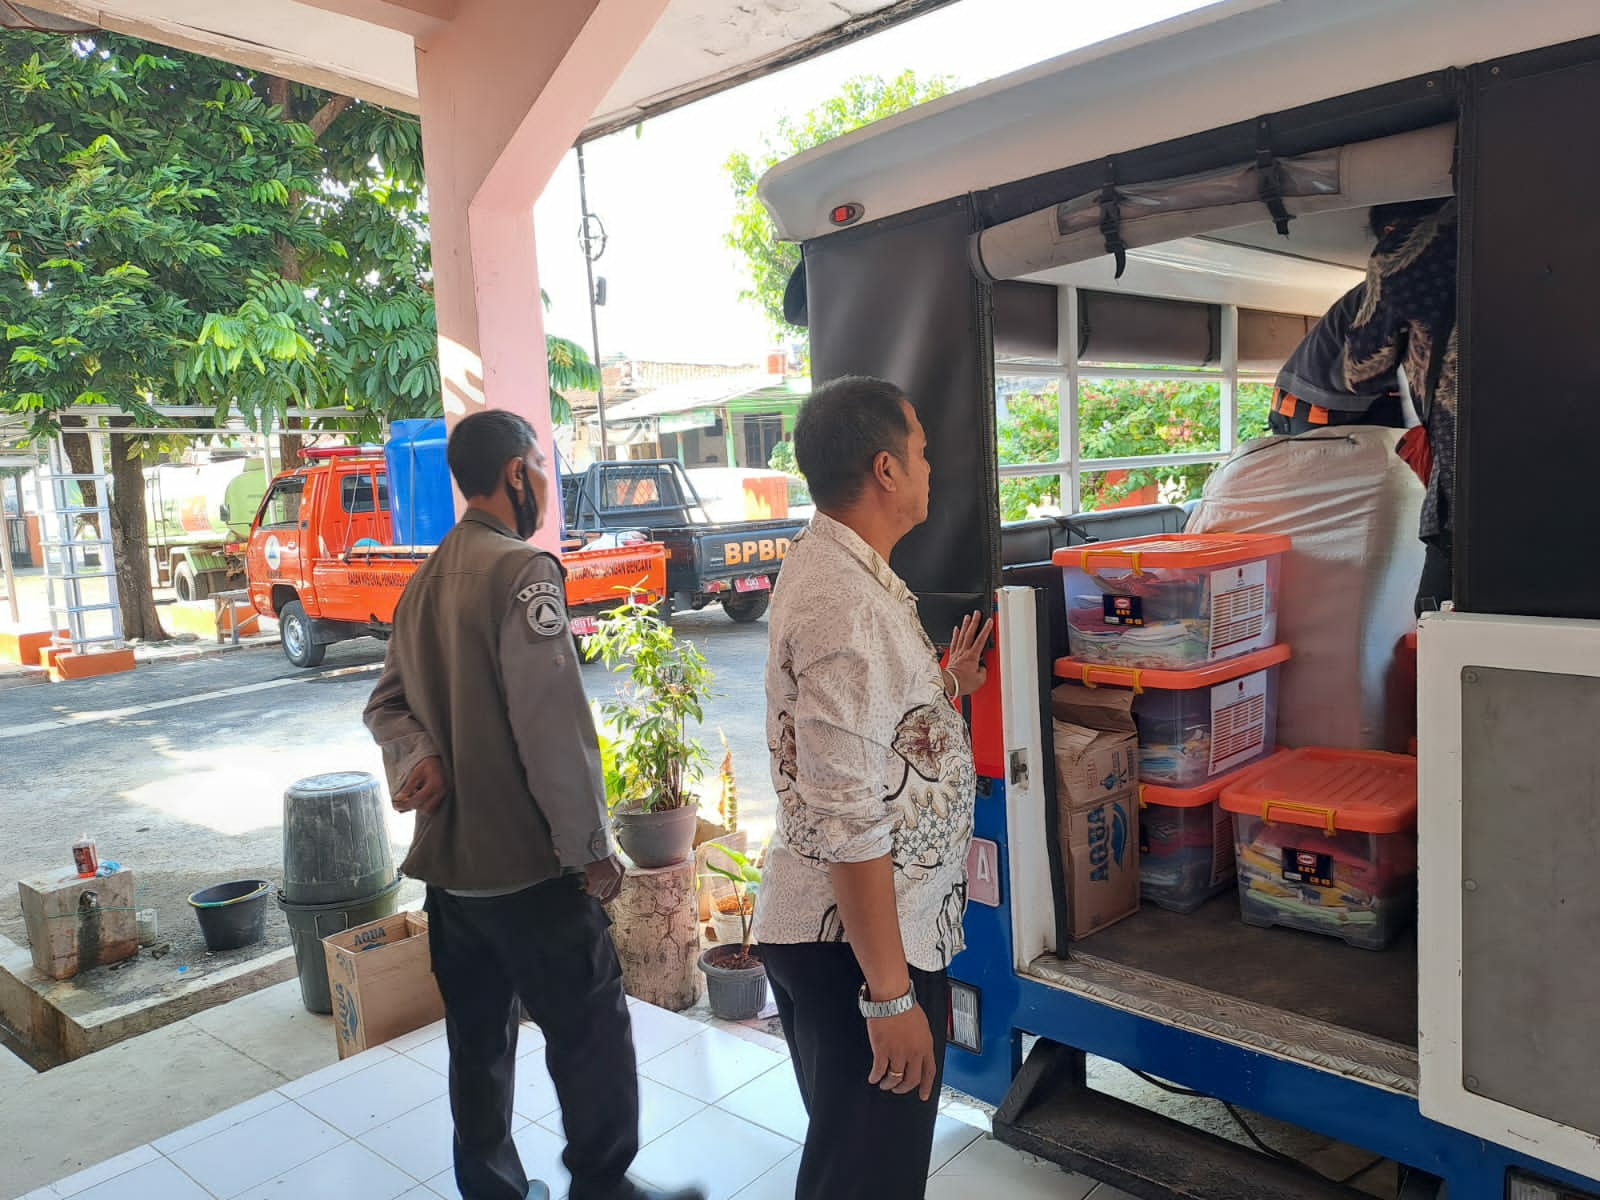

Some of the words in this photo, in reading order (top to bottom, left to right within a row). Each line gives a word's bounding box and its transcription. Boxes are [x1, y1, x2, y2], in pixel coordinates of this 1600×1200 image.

[724, 537, 791, 566] BPBD
[1087, 806, 1110, 881] AQUA
[976, 846, 991, 883] A
[354, 926, 387, 947] AQUA
